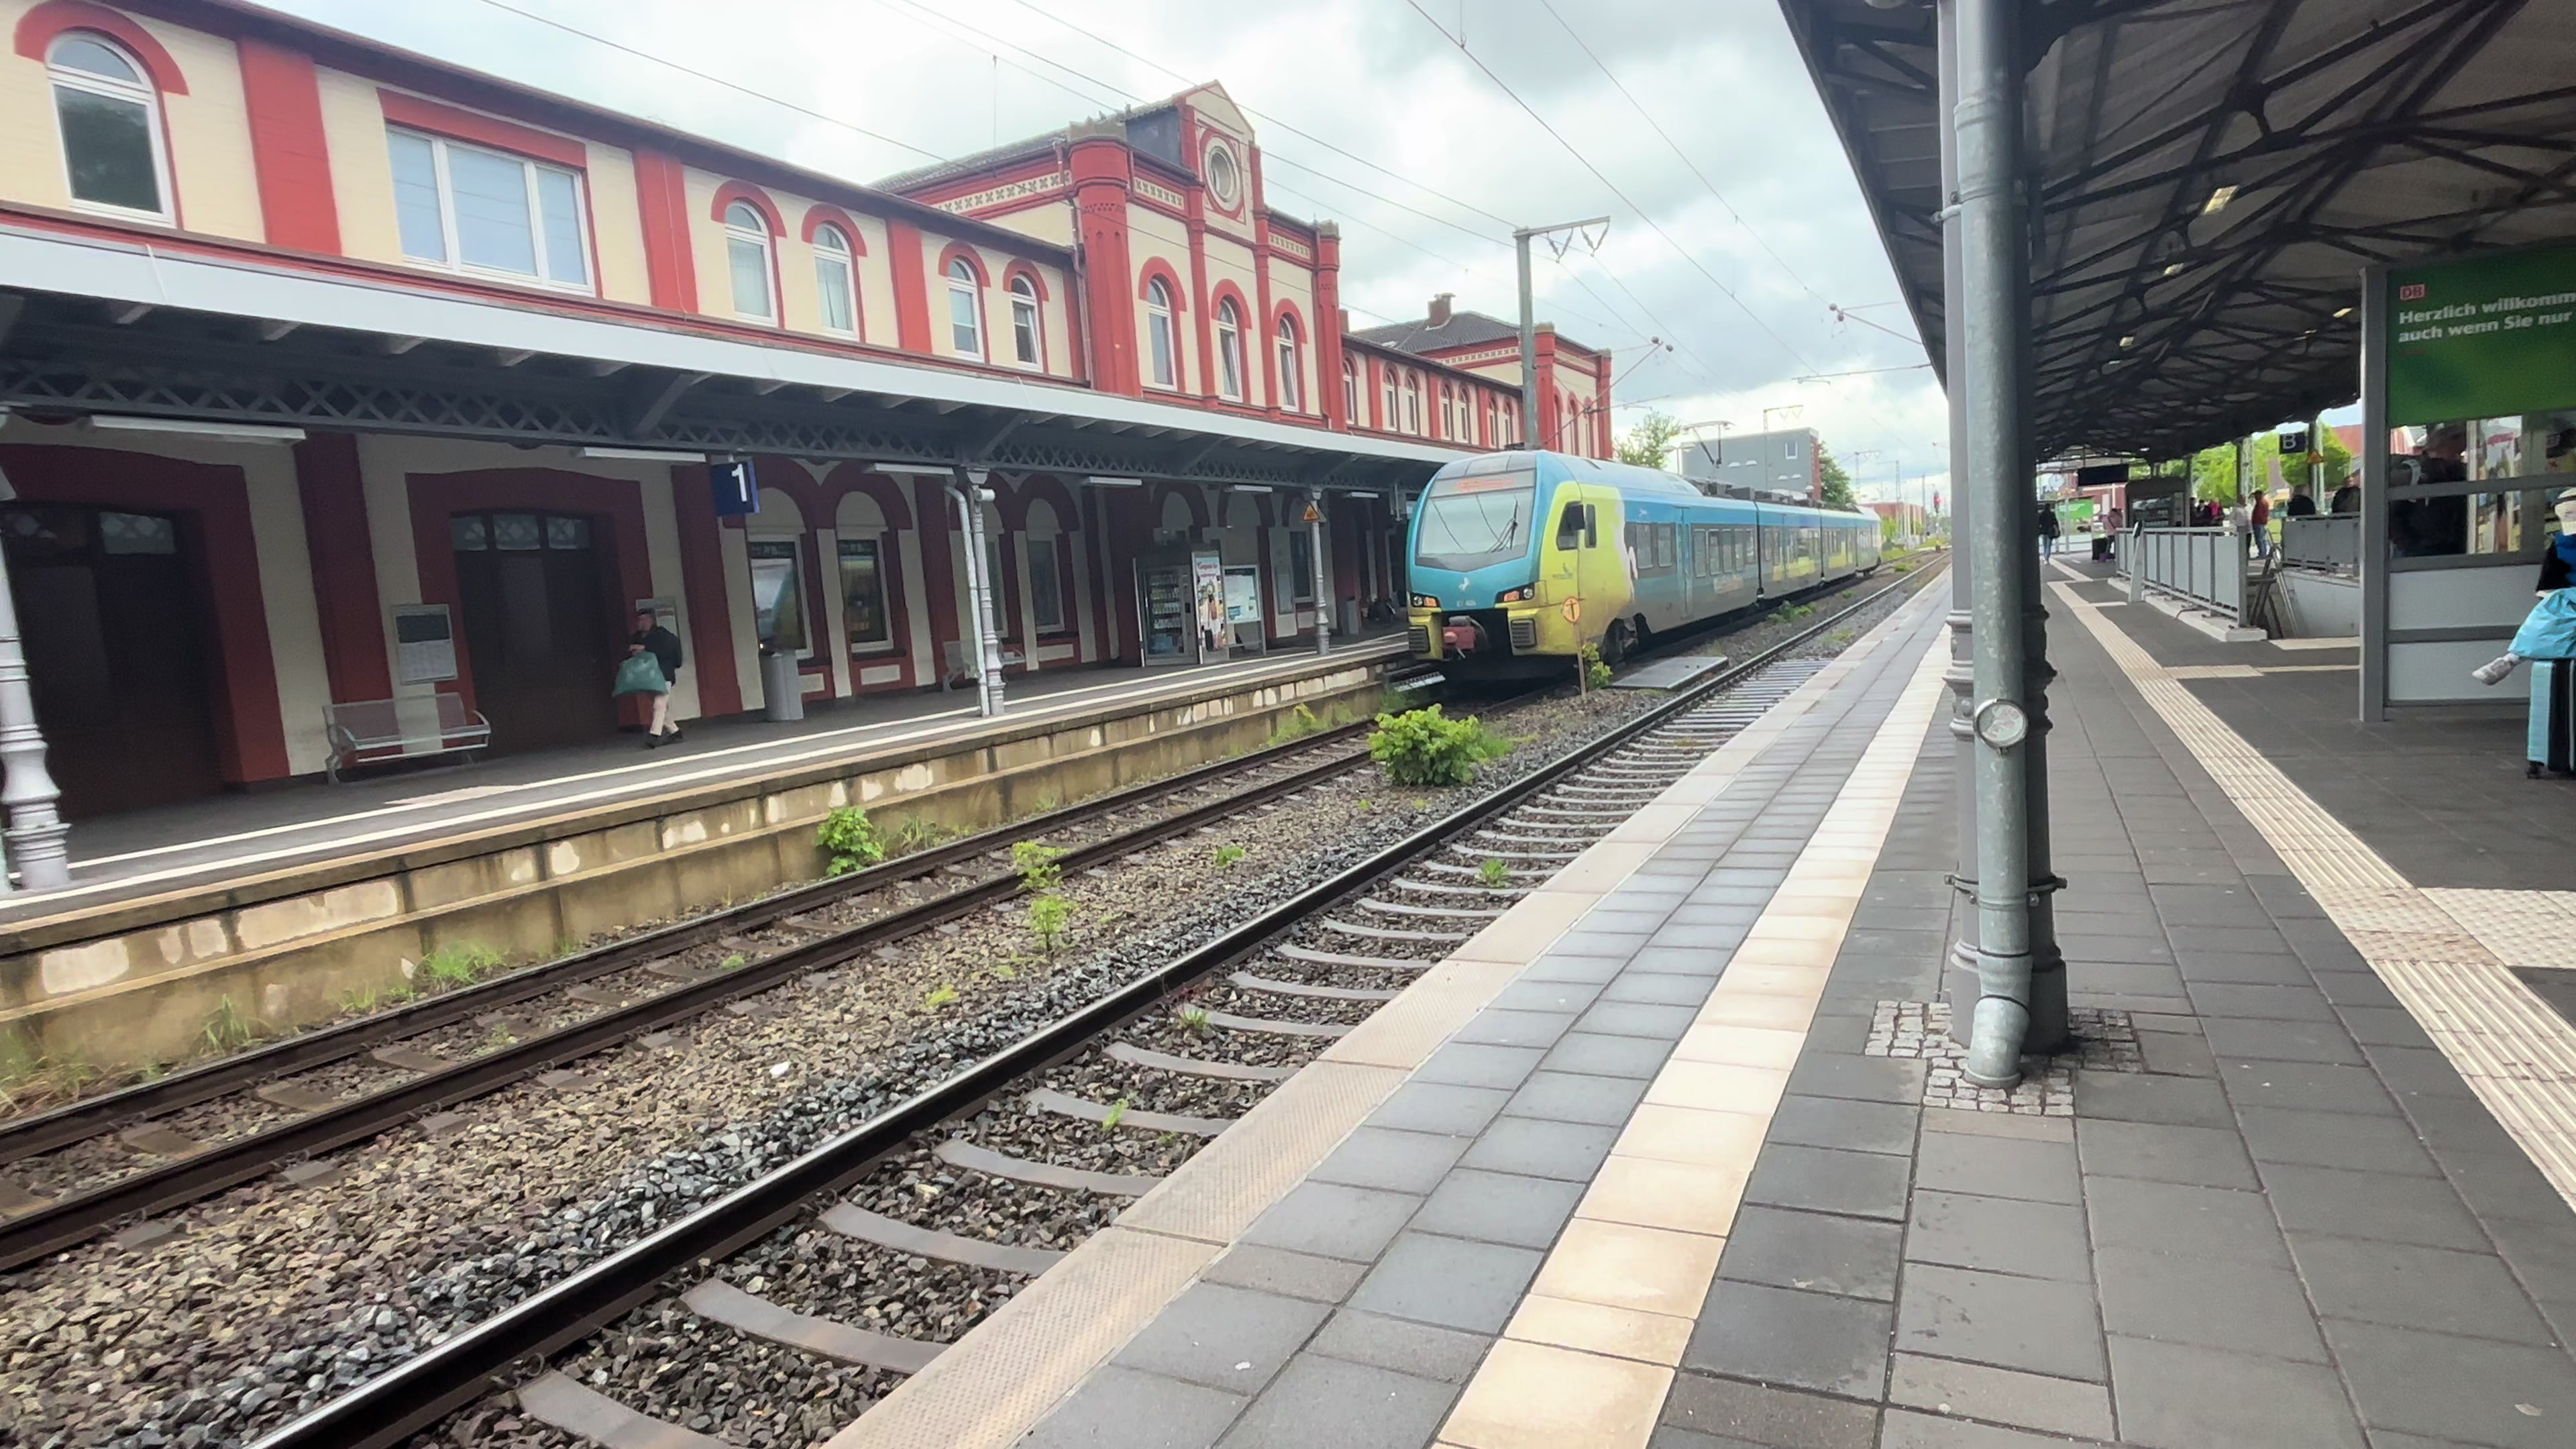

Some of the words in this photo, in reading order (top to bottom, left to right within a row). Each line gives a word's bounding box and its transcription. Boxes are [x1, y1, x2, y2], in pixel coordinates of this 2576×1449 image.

[2401, 285, 2424, 299] DB
[2399, 303, 2475, 324] Herzlich
[2399, 325, 2442, 342] auch
[2448, 321, 2499, 336] wenn
[2504, 315, 2533, 329] Sie
[2538, 311, 2573, 325] nur
[2282, 433, 2297, 449] B
[731, 464, 748, 502] 1
